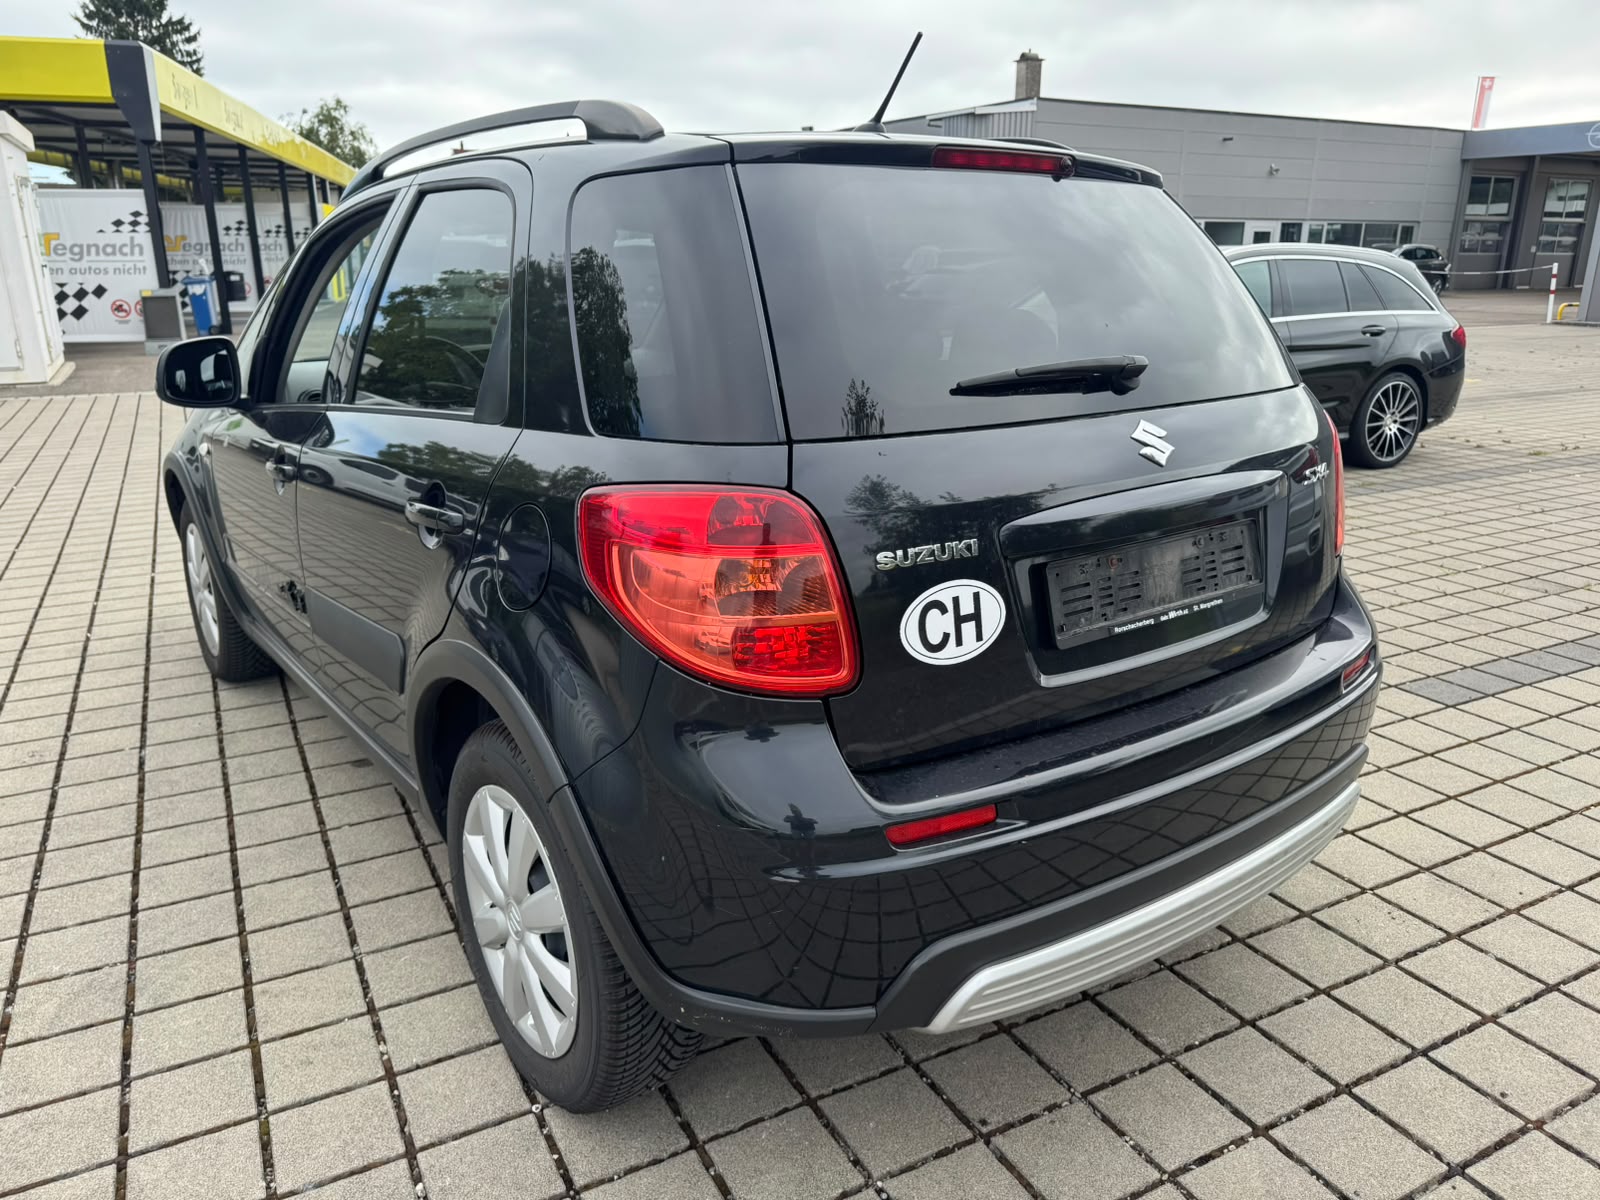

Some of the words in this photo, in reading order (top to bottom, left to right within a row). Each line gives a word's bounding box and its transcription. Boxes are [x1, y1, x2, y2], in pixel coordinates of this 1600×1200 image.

[69, 265, 109, 276] autos
[113, 263, 148, 276] nicht
[1303, 462, 1330, 485] SX4
[876, 538, 979, 570] SUZUKI
[918, 591, 984, 653] CH
